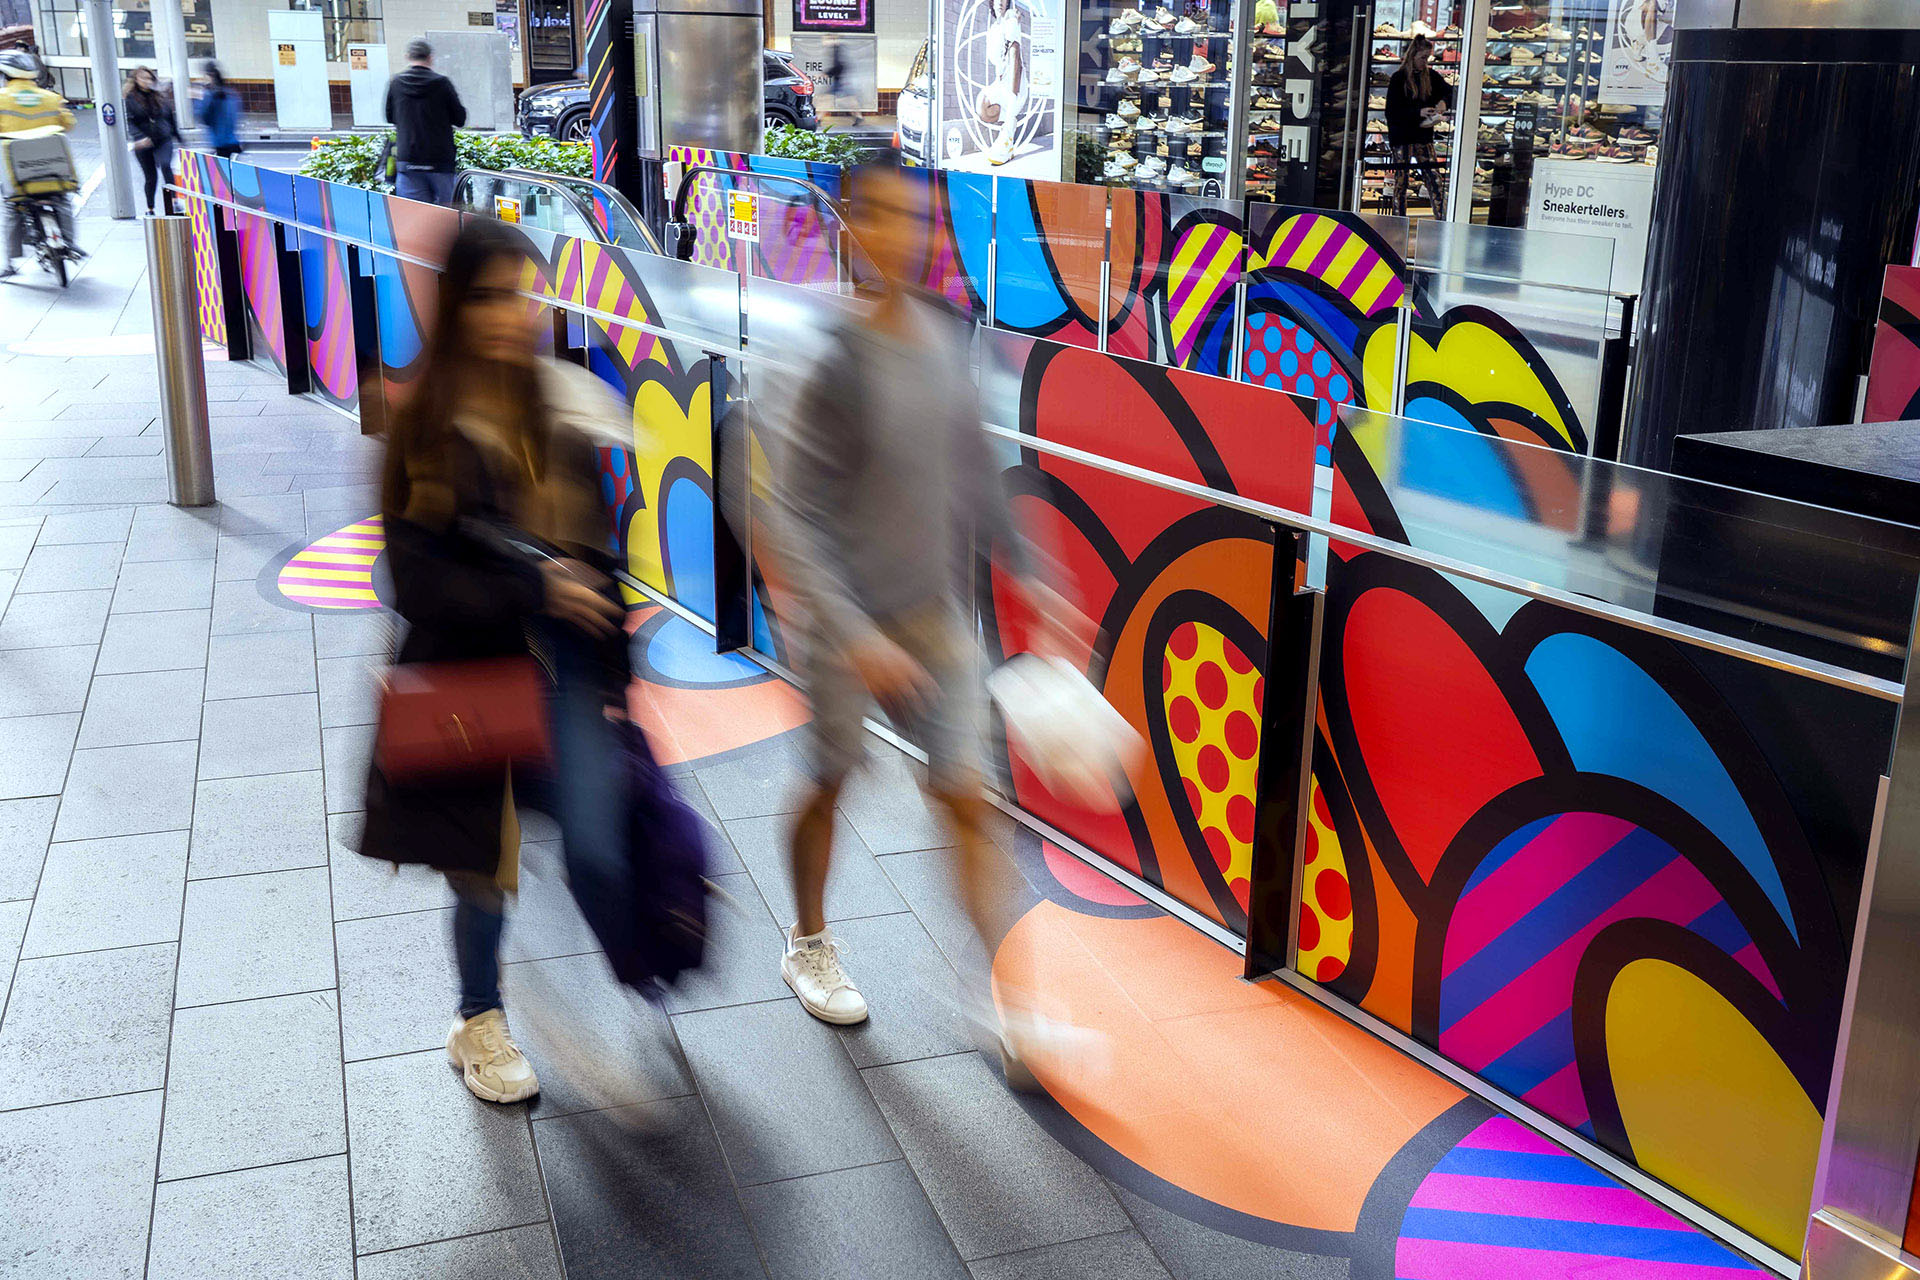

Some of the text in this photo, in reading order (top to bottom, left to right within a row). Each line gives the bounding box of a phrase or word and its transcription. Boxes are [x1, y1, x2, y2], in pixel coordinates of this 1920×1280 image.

[805, 61, 823, 72] FIRE
[1544, 183, 1595, 199] Hype DC
[1541, 214, 1565, 224] Everyone
[1591, 218, 1614, 227] sneaker
